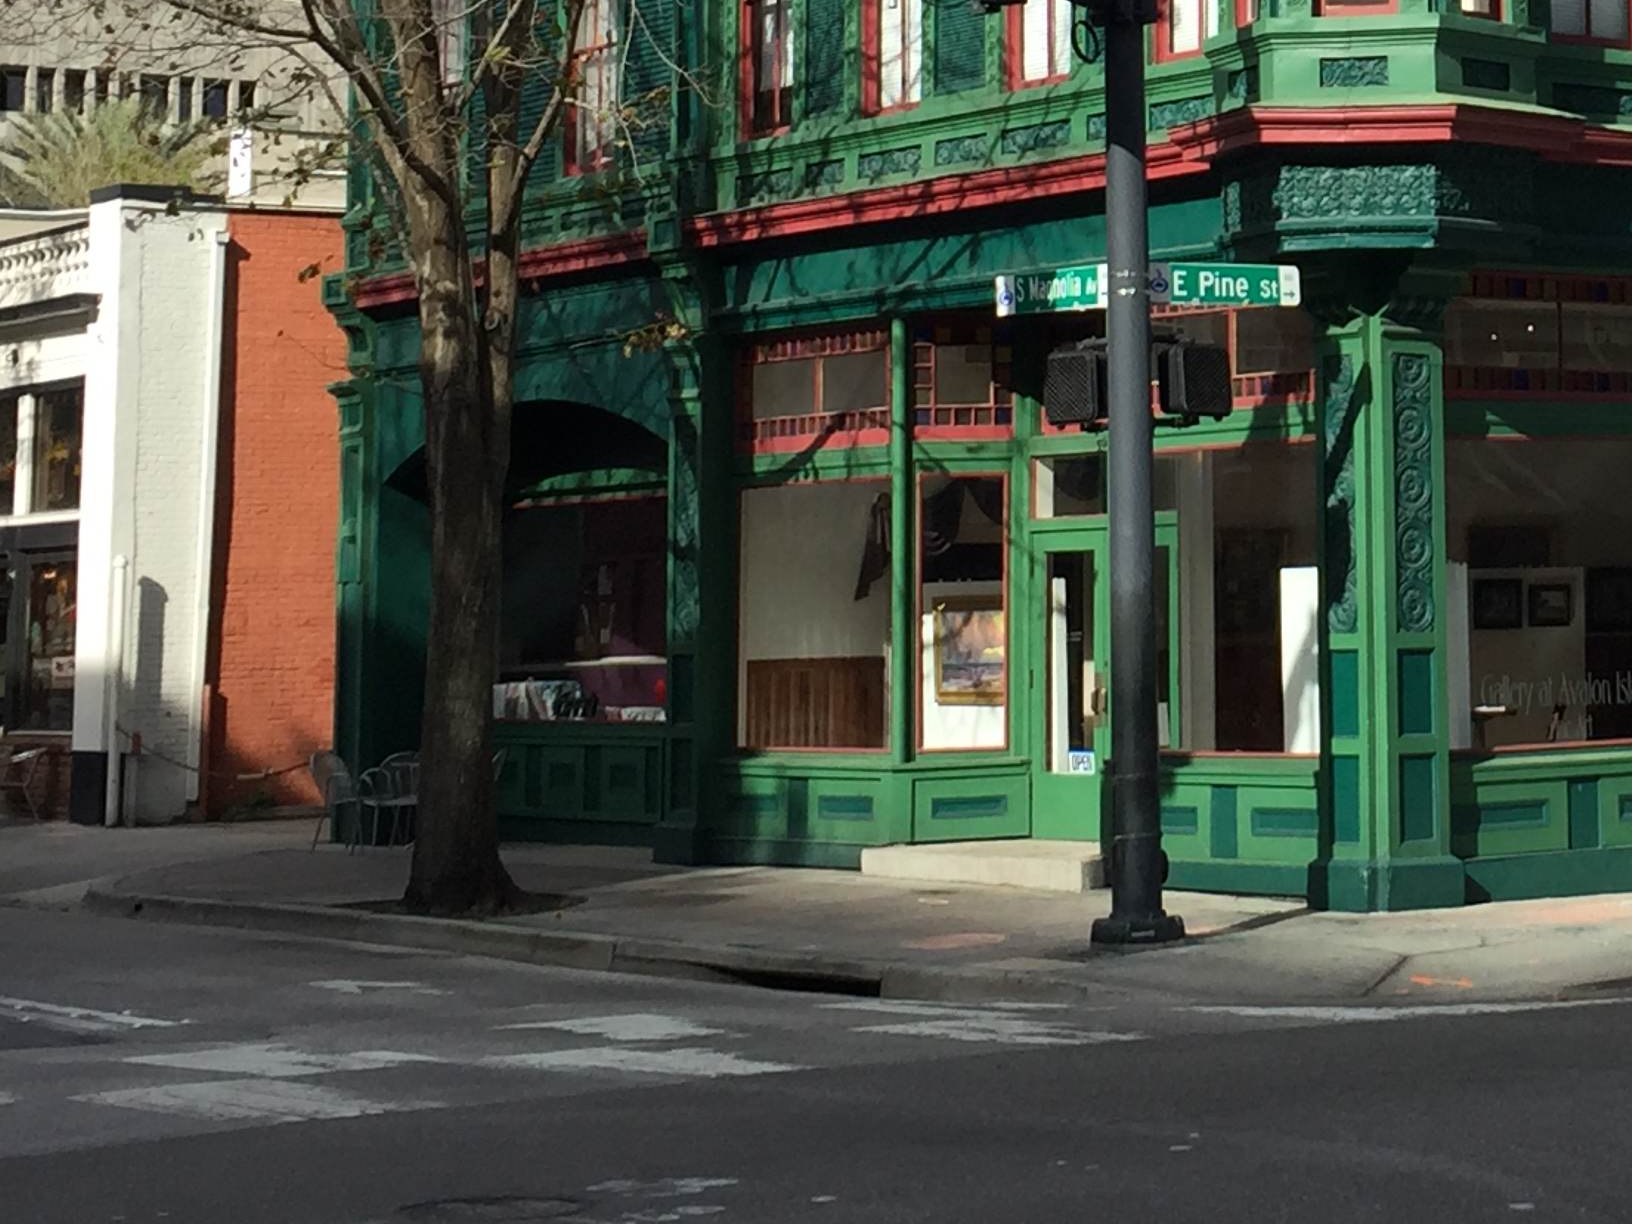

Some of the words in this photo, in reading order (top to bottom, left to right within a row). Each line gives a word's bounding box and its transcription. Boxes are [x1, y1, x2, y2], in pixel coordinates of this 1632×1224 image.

[1016, 277, 1025, 302] S
[1029, 272, 1081, 306] Magnolia
[1173, 270, 1188, 297] E
[1199, 271, 1249, 298] Pine
[1481, 673, 1534, 714] Gallery
[1559, 671, 1612, 704] Avalon
